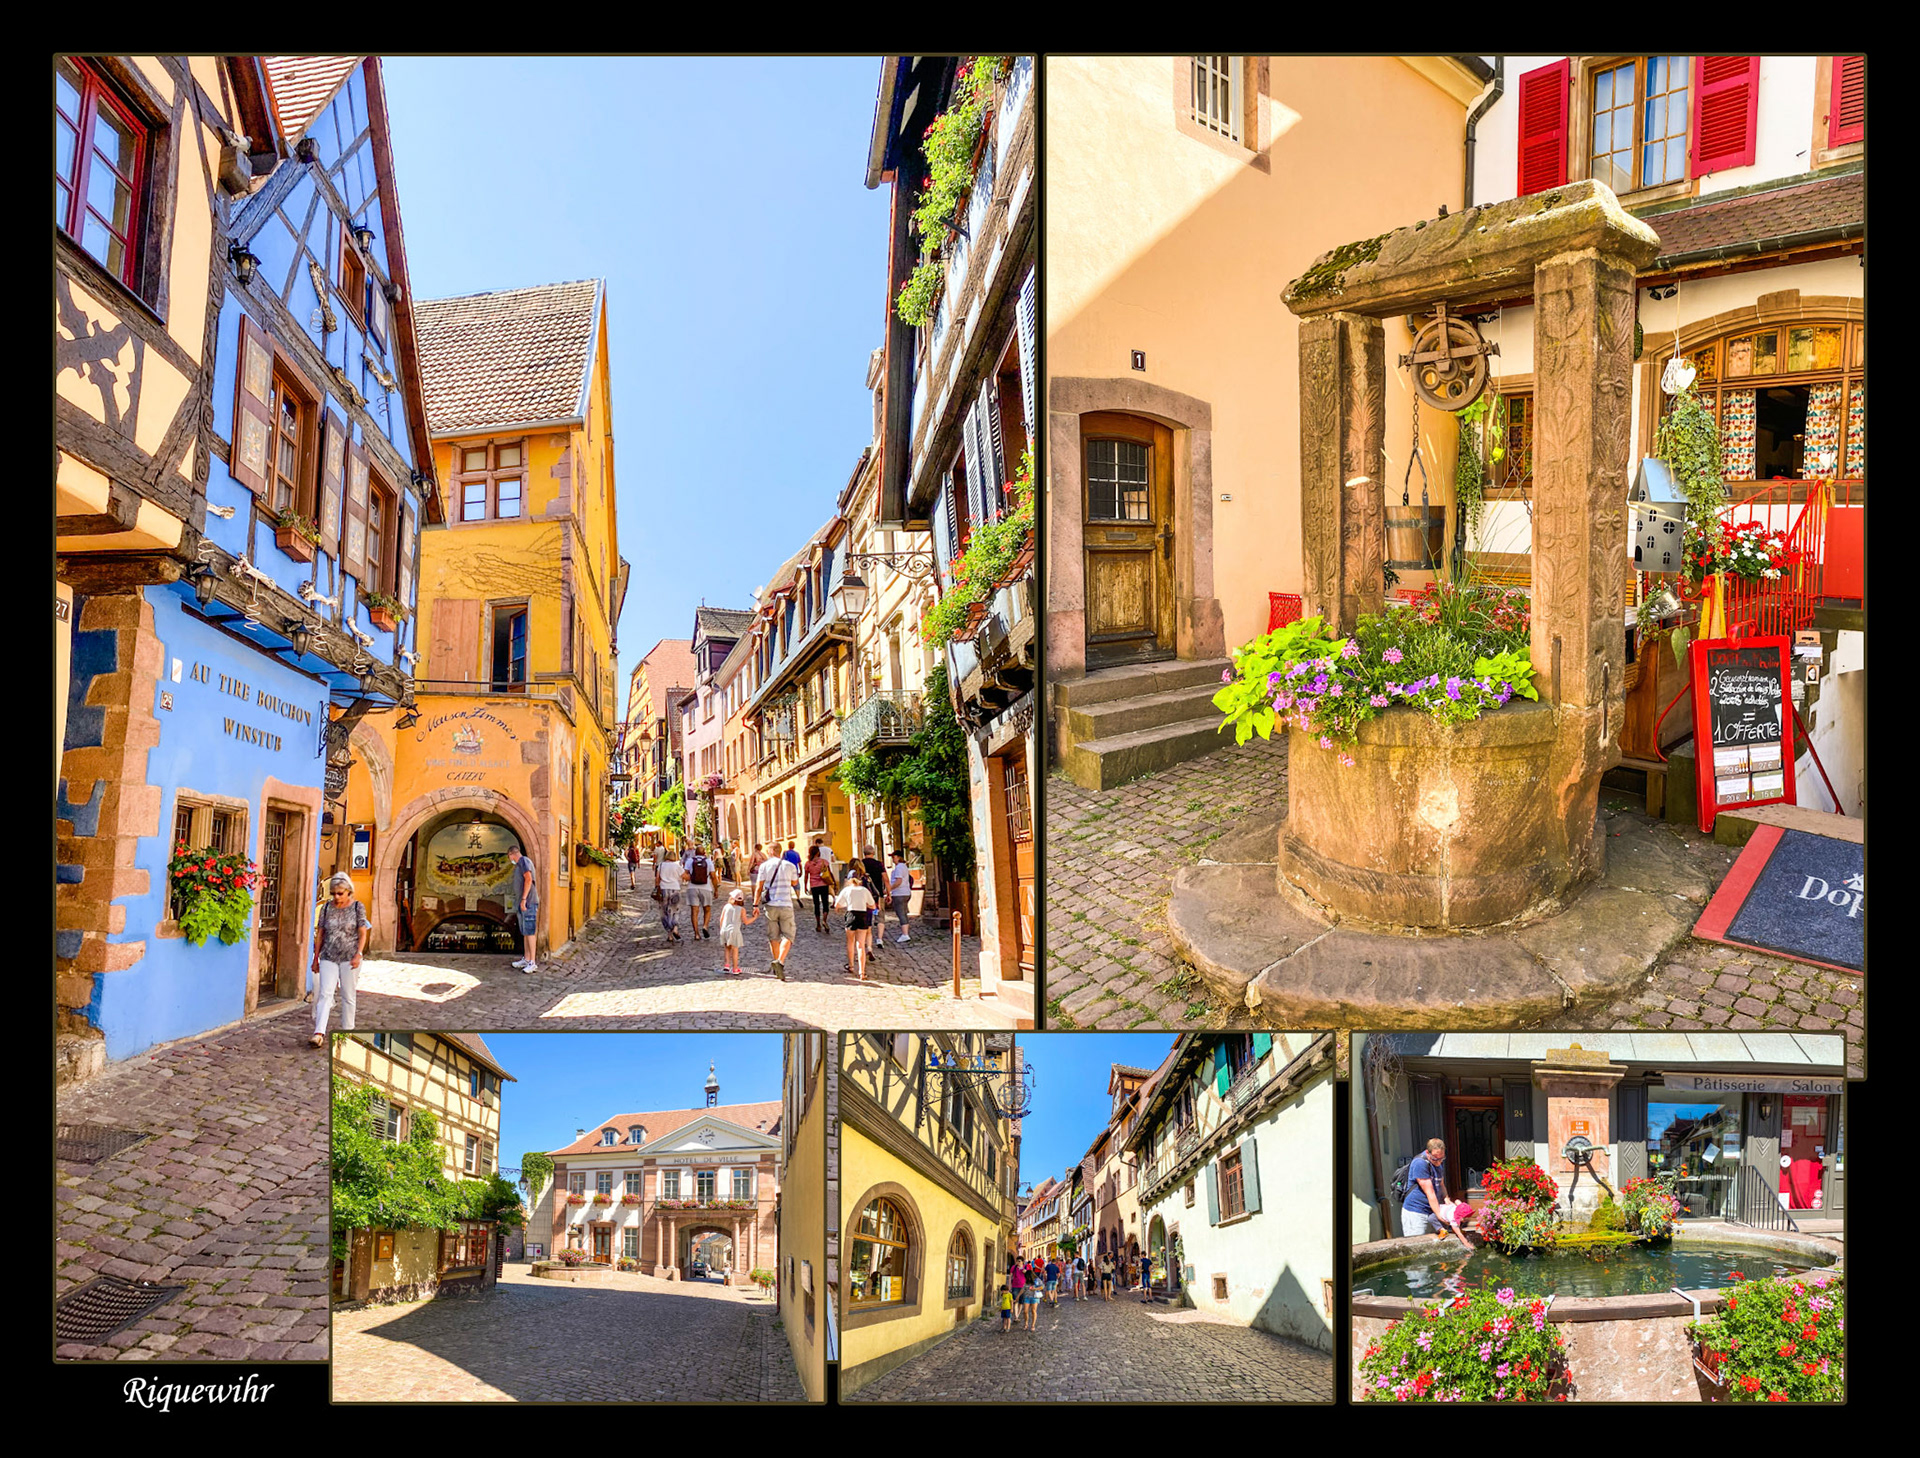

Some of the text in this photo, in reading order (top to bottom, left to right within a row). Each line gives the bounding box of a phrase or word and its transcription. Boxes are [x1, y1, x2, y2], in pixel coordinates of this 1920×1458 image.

[1136, 354, 1142, 368] 1
[56, 600, 68, 618] 27
[190, 661, 312, 727] AU TIRE BOUCHON
[224, 716, 282, 752] WINSTUB
[416, 710, 467, 742] Maison
[1713, 715, 1726, 744] 1
[446, 771, 486, 781] CAVEAU
[1693, 1077, 1766, 1092] Pâtisserie
[1791, 1079, 1832, 1093] Salon
[1513, 1109, 1524, 1118] 24
